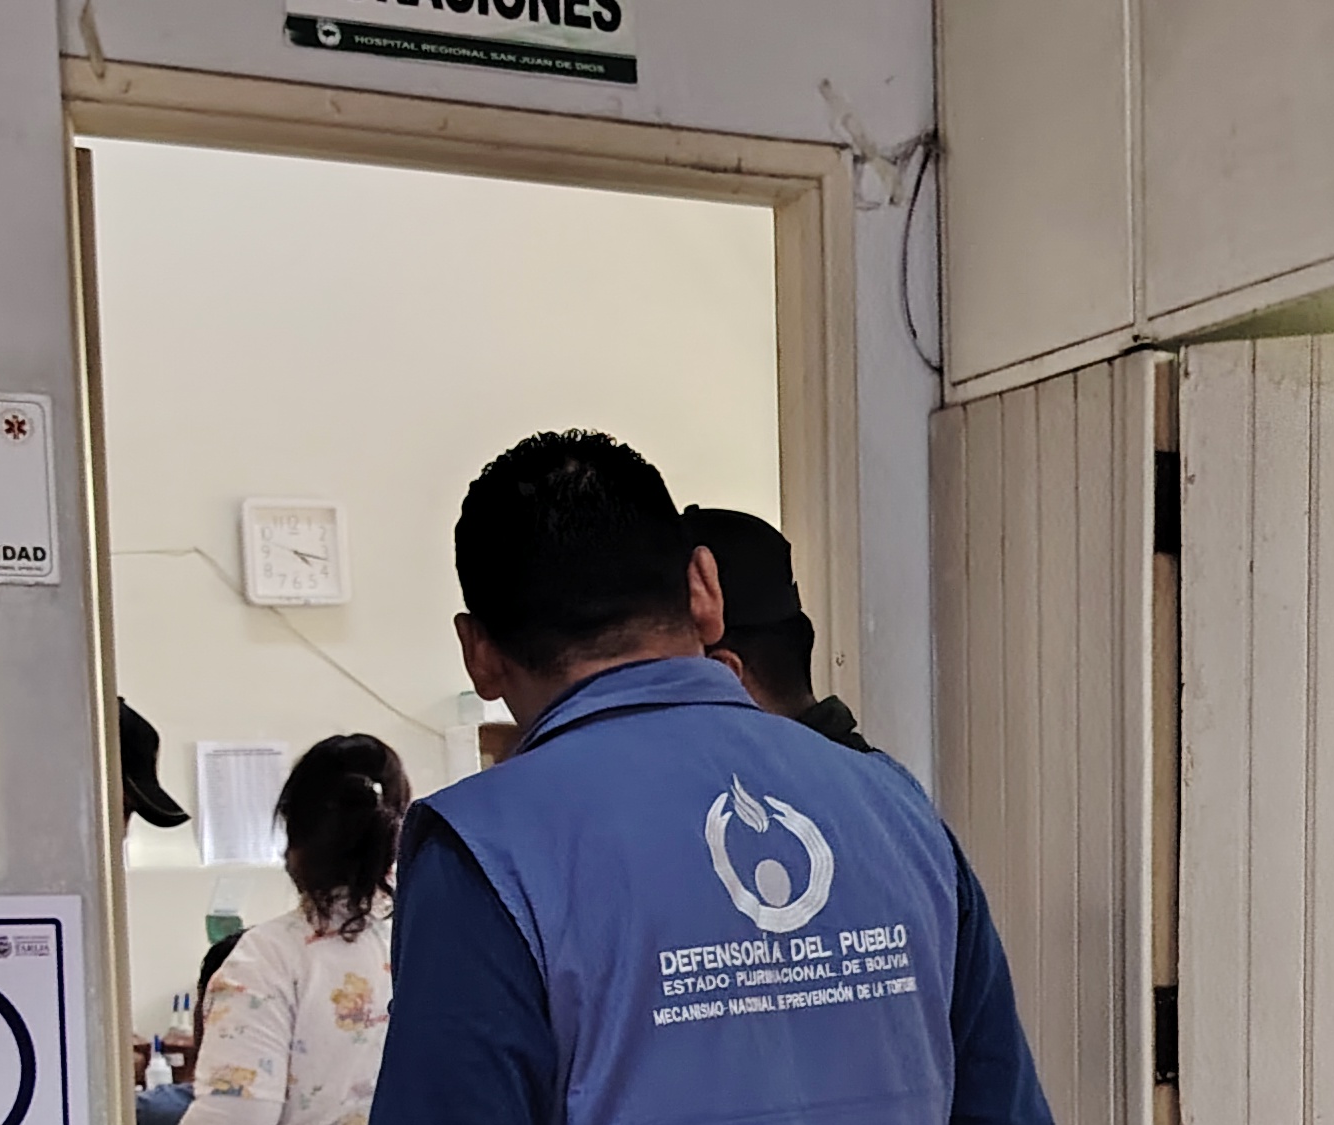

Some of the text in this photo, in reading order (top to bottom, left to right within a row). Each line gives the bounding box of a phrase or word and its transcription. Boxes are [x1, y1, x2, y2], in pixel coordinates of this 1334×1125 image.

[354, 35, 605, 74] HOSPITAL REGIONAL SAN JUAN DE DIOS
[659, 924, 907, 976] DEFENSORÍA DEL PUEBLO
[662, 973, 730, 997] ESTADO
[842, 959, 861, 976] DE
[865, 952, 909, 972] BOLIVIA
[856, 984, 871, 1000] DE
[872, 982, 884, 998] LA
